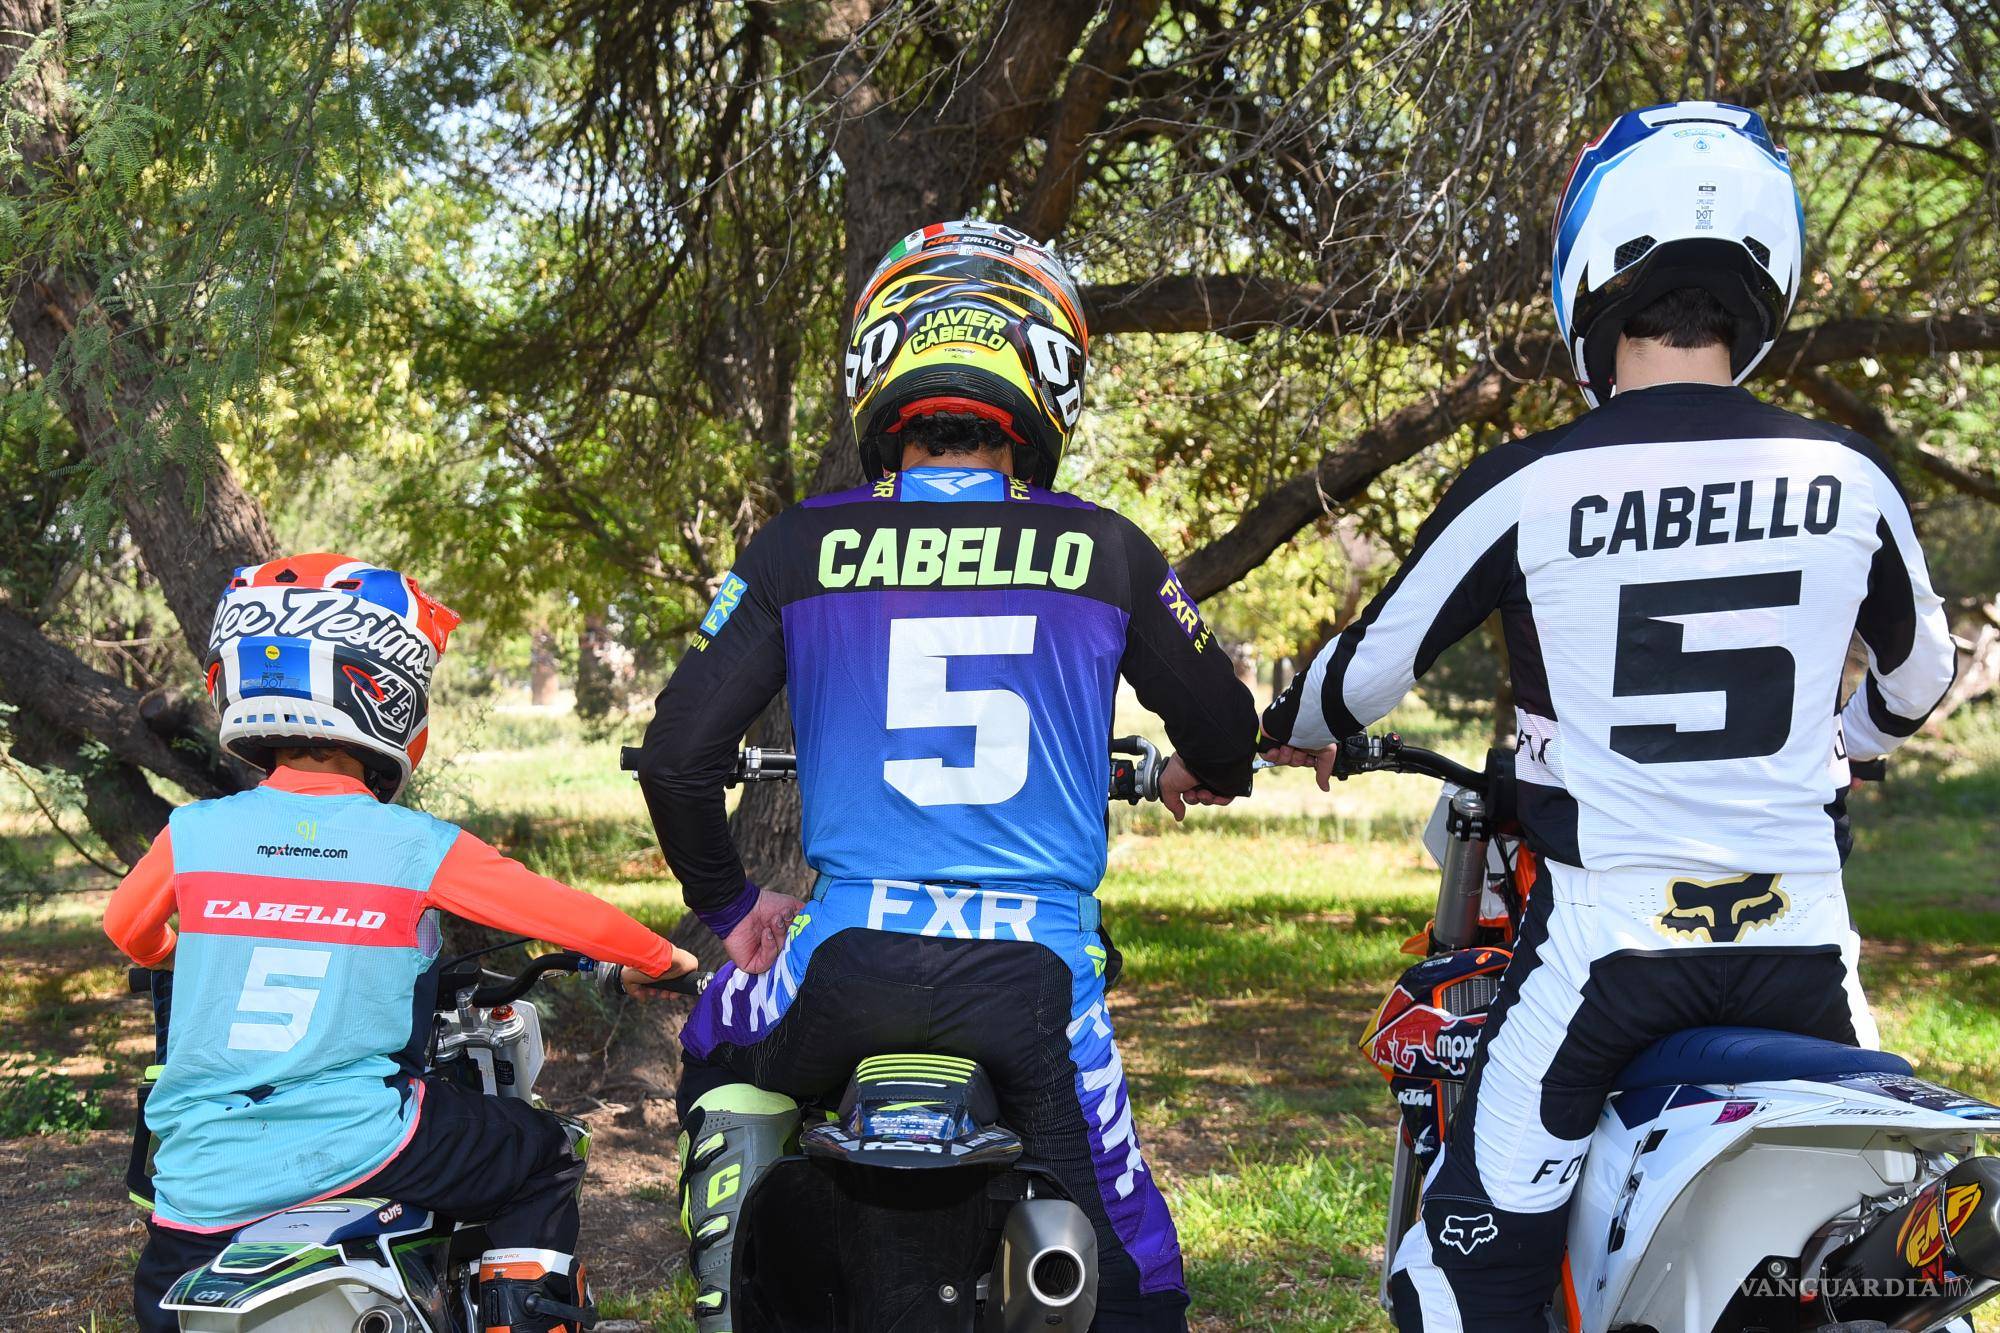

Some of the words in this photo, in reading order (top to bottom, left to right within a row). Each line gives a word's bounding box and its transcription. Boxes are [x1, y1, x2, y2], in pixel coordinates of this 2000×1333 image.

[962, 235, 1013, 252] SALTILLO
[911, 325, 1006, 354] CABELLO
[919, 308, 1007, 333] JAVIER
[1567, 474, 1842, 559] CABELLO
[817, 526, 1095, 590] CABELLO
[704, 578, 744, 631] FXR
[1160, 578, 1198, 634] FXR
[276, 588, 434, 680] Designs
[1608, 570, 1803, 765] 5
[883, 615, 1038, 807] 5
[256, 843, 348, 859] mpxtreme.com
[202, 900, 387, 930] CABELLO
[866, 878, 1039, 943] FXR
[227, 946, 332, 1052] 5
[1397, 1088, 1433, 1107] KTM
[1829, 1107, 1915, 1117] DUNLOP
[707, 1163, 741, 1209] G
[378, 1202, 403, 1224] GUTS
